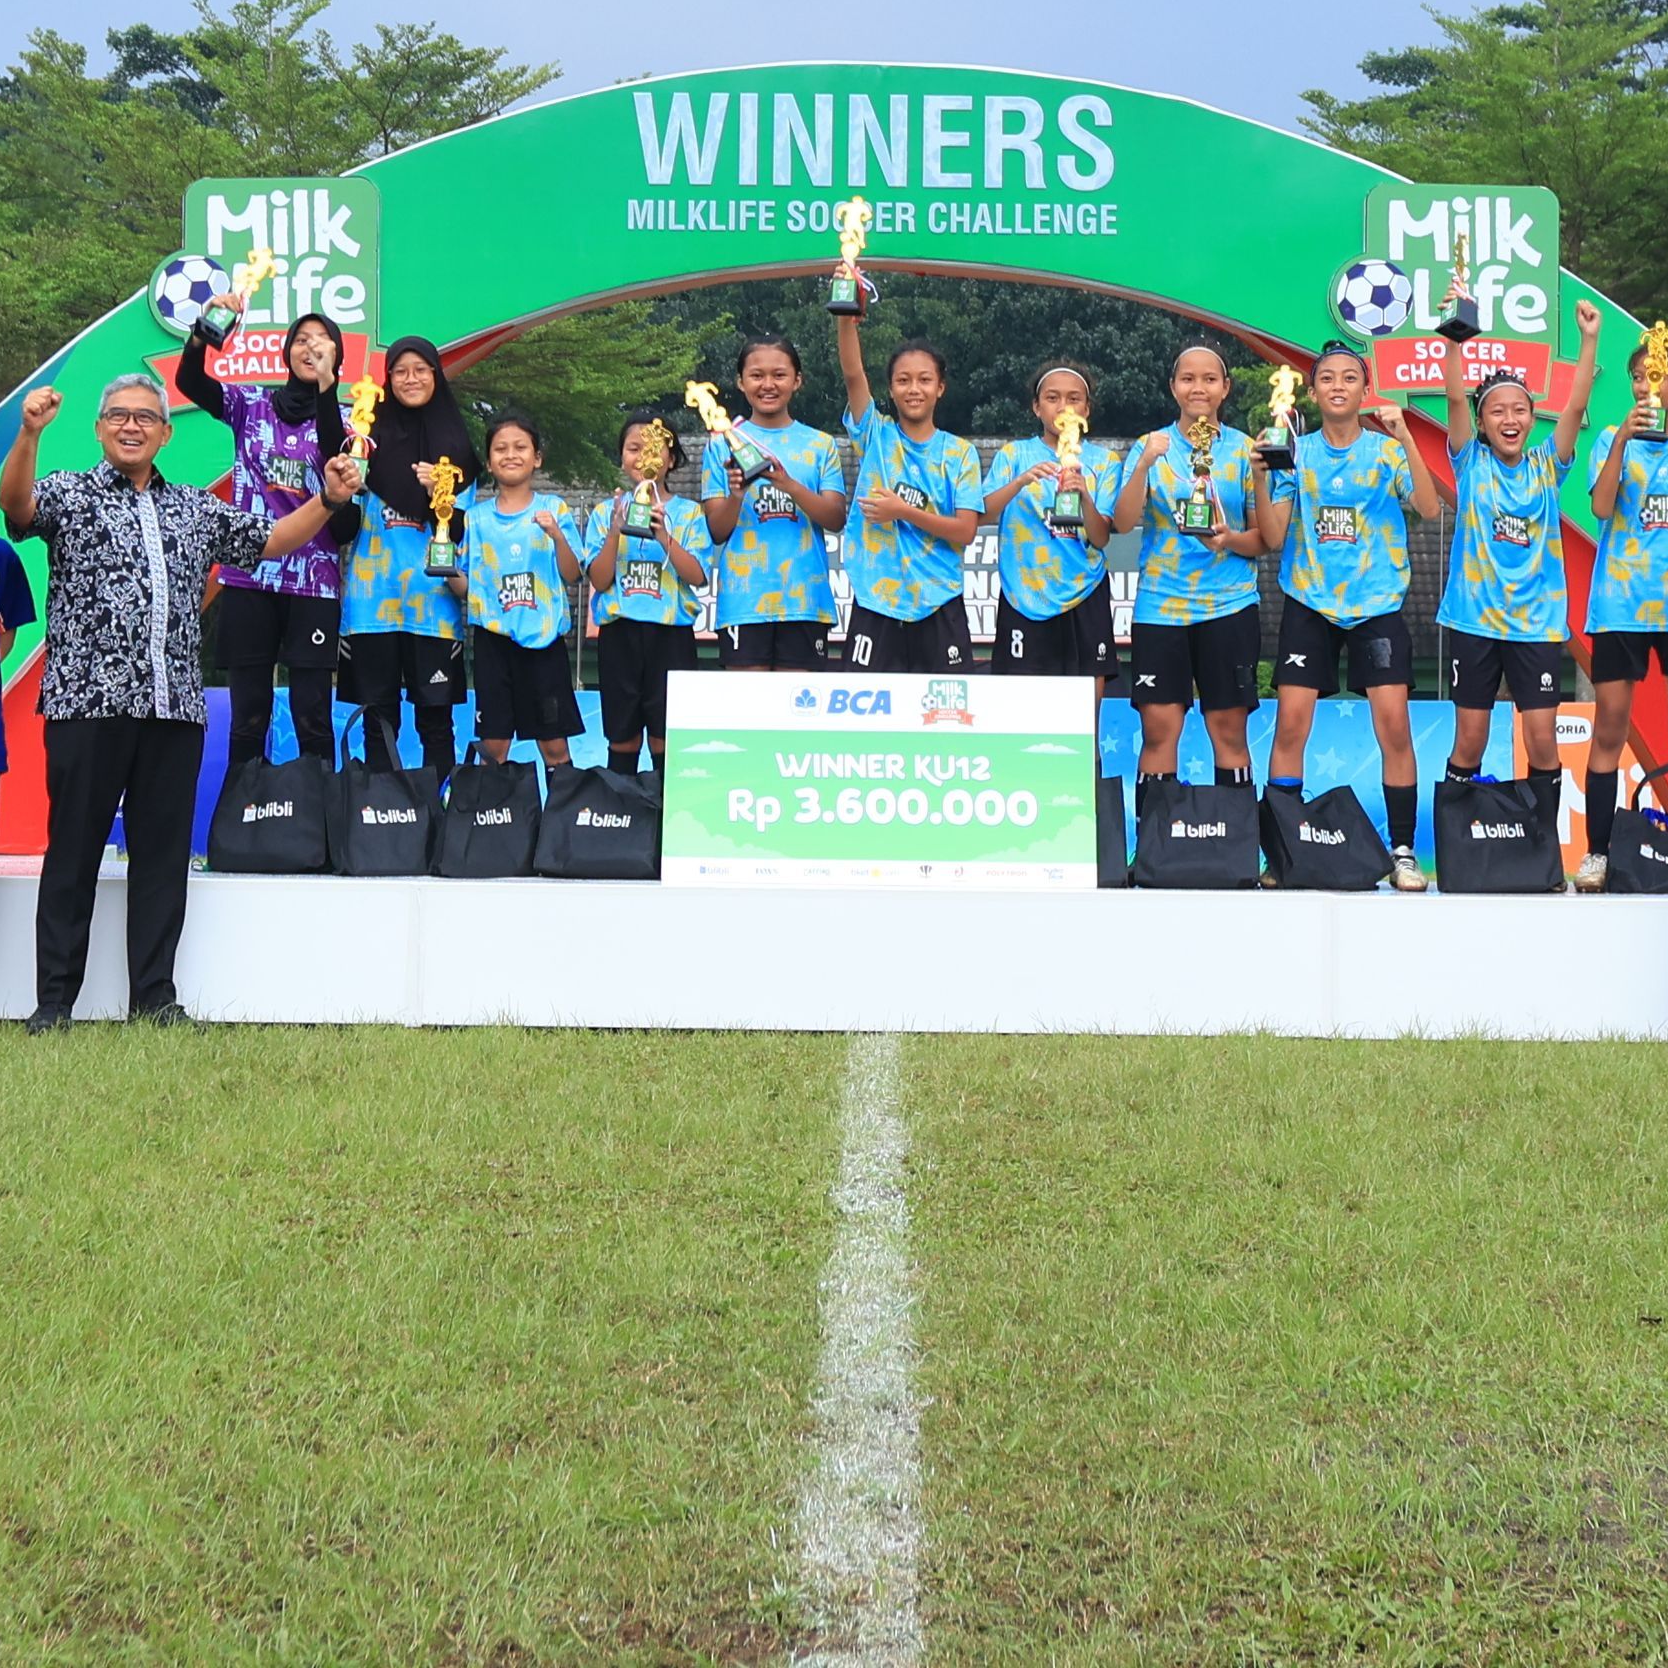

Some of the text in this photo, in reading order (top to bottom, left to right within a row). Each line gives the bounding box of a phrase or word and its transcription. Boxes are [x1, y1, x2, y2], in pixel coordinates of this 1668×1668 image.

[633, 92, 1115, 191] WINNERS
[207, 189, 360, 258] Milk
[627, 199, 776, 231] MILKLIFE
[928, 203, 1118, 235] CHALLENGE
[1388, 196, 1543, 267] Milk
[1414, 341, 1507, 362] SOCER
[273, 459, 302, 476] Milk
[277, 473, 302, 489] Life
[769, 498, 794, 513] Life
[1323, 508, 1353, 523] Milk
[1328, 521, 1354, 536] Life
[629, 563, 659, 577] Milk
[505, 574, 532, 589] Milk
[634, 575, 659, 590] Life
[511, 586, 533, 601] Life
[852, 634, 873, 664] 10
[1011, 629, 1024, 658] 8
[931, 682, 965, 696] Milk
[826, 689, 892, 716] BCA
[937, 694, 967, 710] Life
[1556, 724, 1587, 734] ORIA
[775, 752, 992, 788] WINNER KU12
[257, 801, 293, 820] blibli
[377, 809, 417, 824] blibli
[476, 807, 512, 826] blibli
[728, 787, 1039, 832] Rp 3.600.000
[591, 812, 631, 828] blibli
[1187, 822, 1226, 839] blibli
[1311, 827, 1346, 845] blibli
[1485, 823, 1525, 839] blibli
